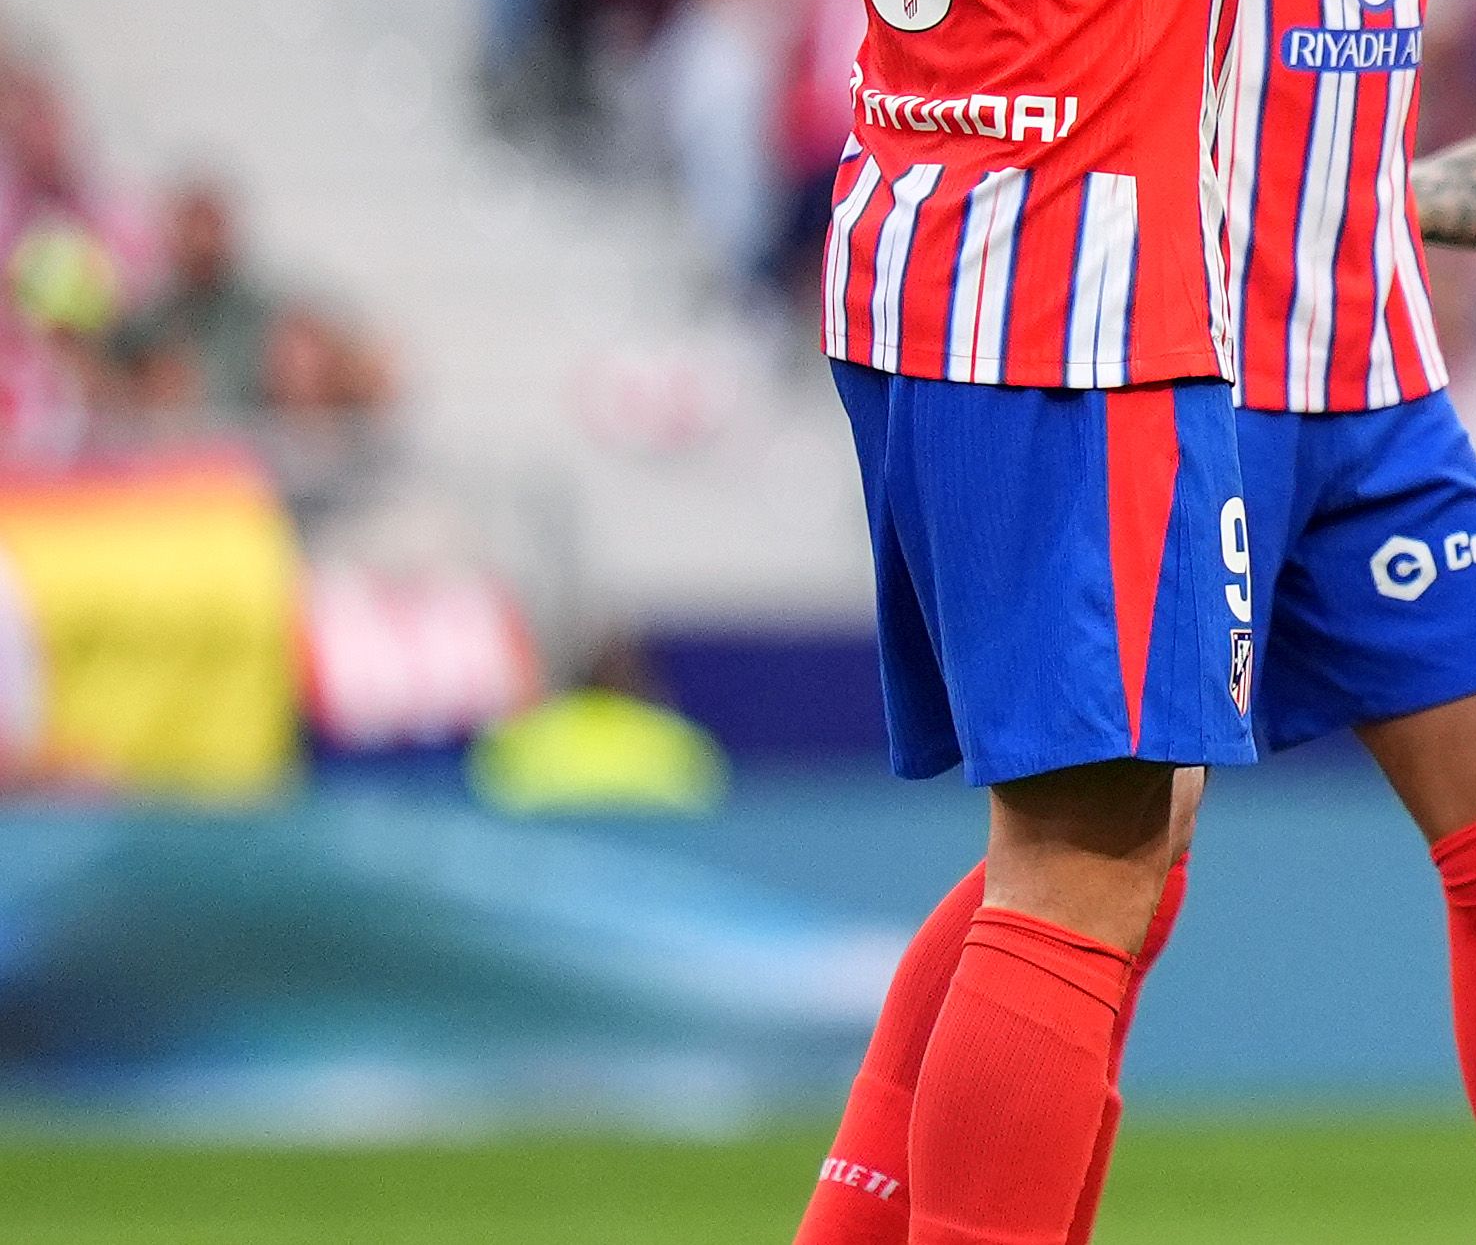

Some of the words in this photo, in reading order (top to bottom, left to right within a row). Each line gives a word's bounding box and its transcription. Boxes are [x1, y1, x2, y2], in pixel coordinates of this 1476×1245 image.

[1290, 31, 1396, 68] RIYADH
[1220, 497, 1252, 623] 9
[819, 1157, 900, 1201] TLETI
